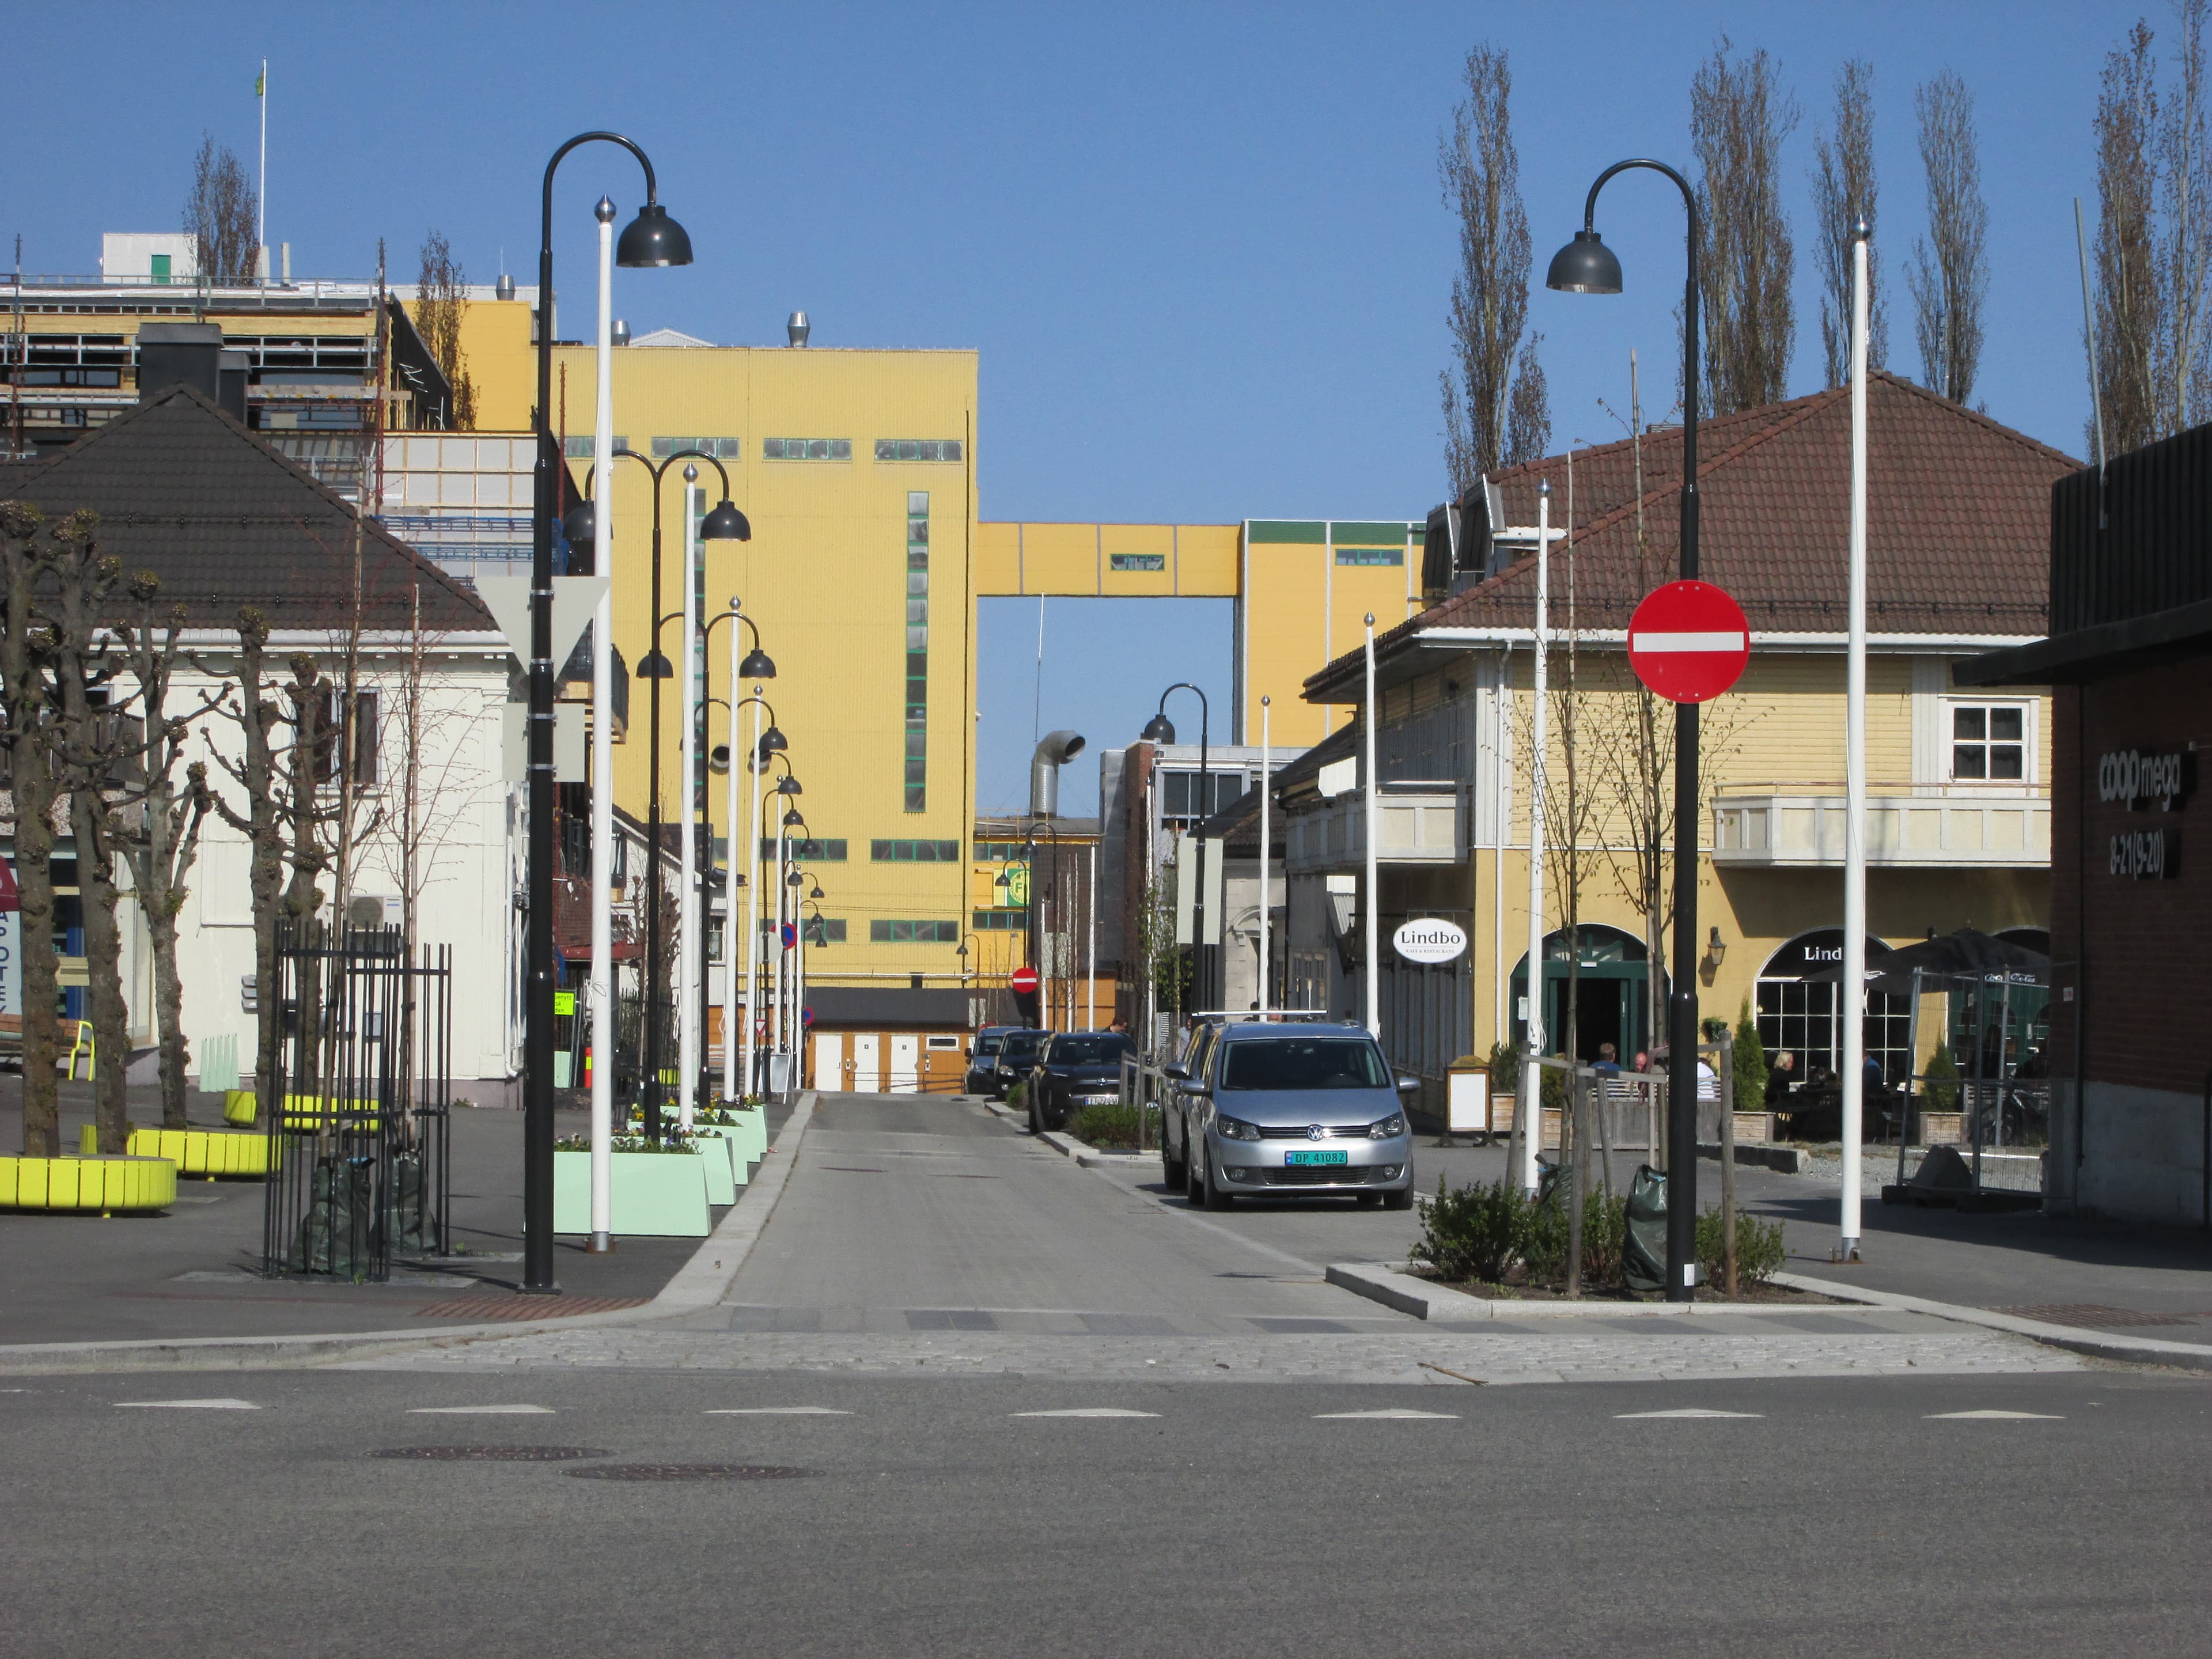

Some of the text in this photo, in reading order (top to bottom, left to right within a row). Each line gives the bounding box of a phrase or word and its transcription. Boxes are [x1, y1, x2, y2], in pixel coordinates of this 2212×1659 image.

[2099, 749, 2180, 812] coop mega
[1401, 931, 1460, 944] Lindbo
[1804, 946, 1844, 960] Lind
[1295, 1153, 1344, 1162] DP 41082
